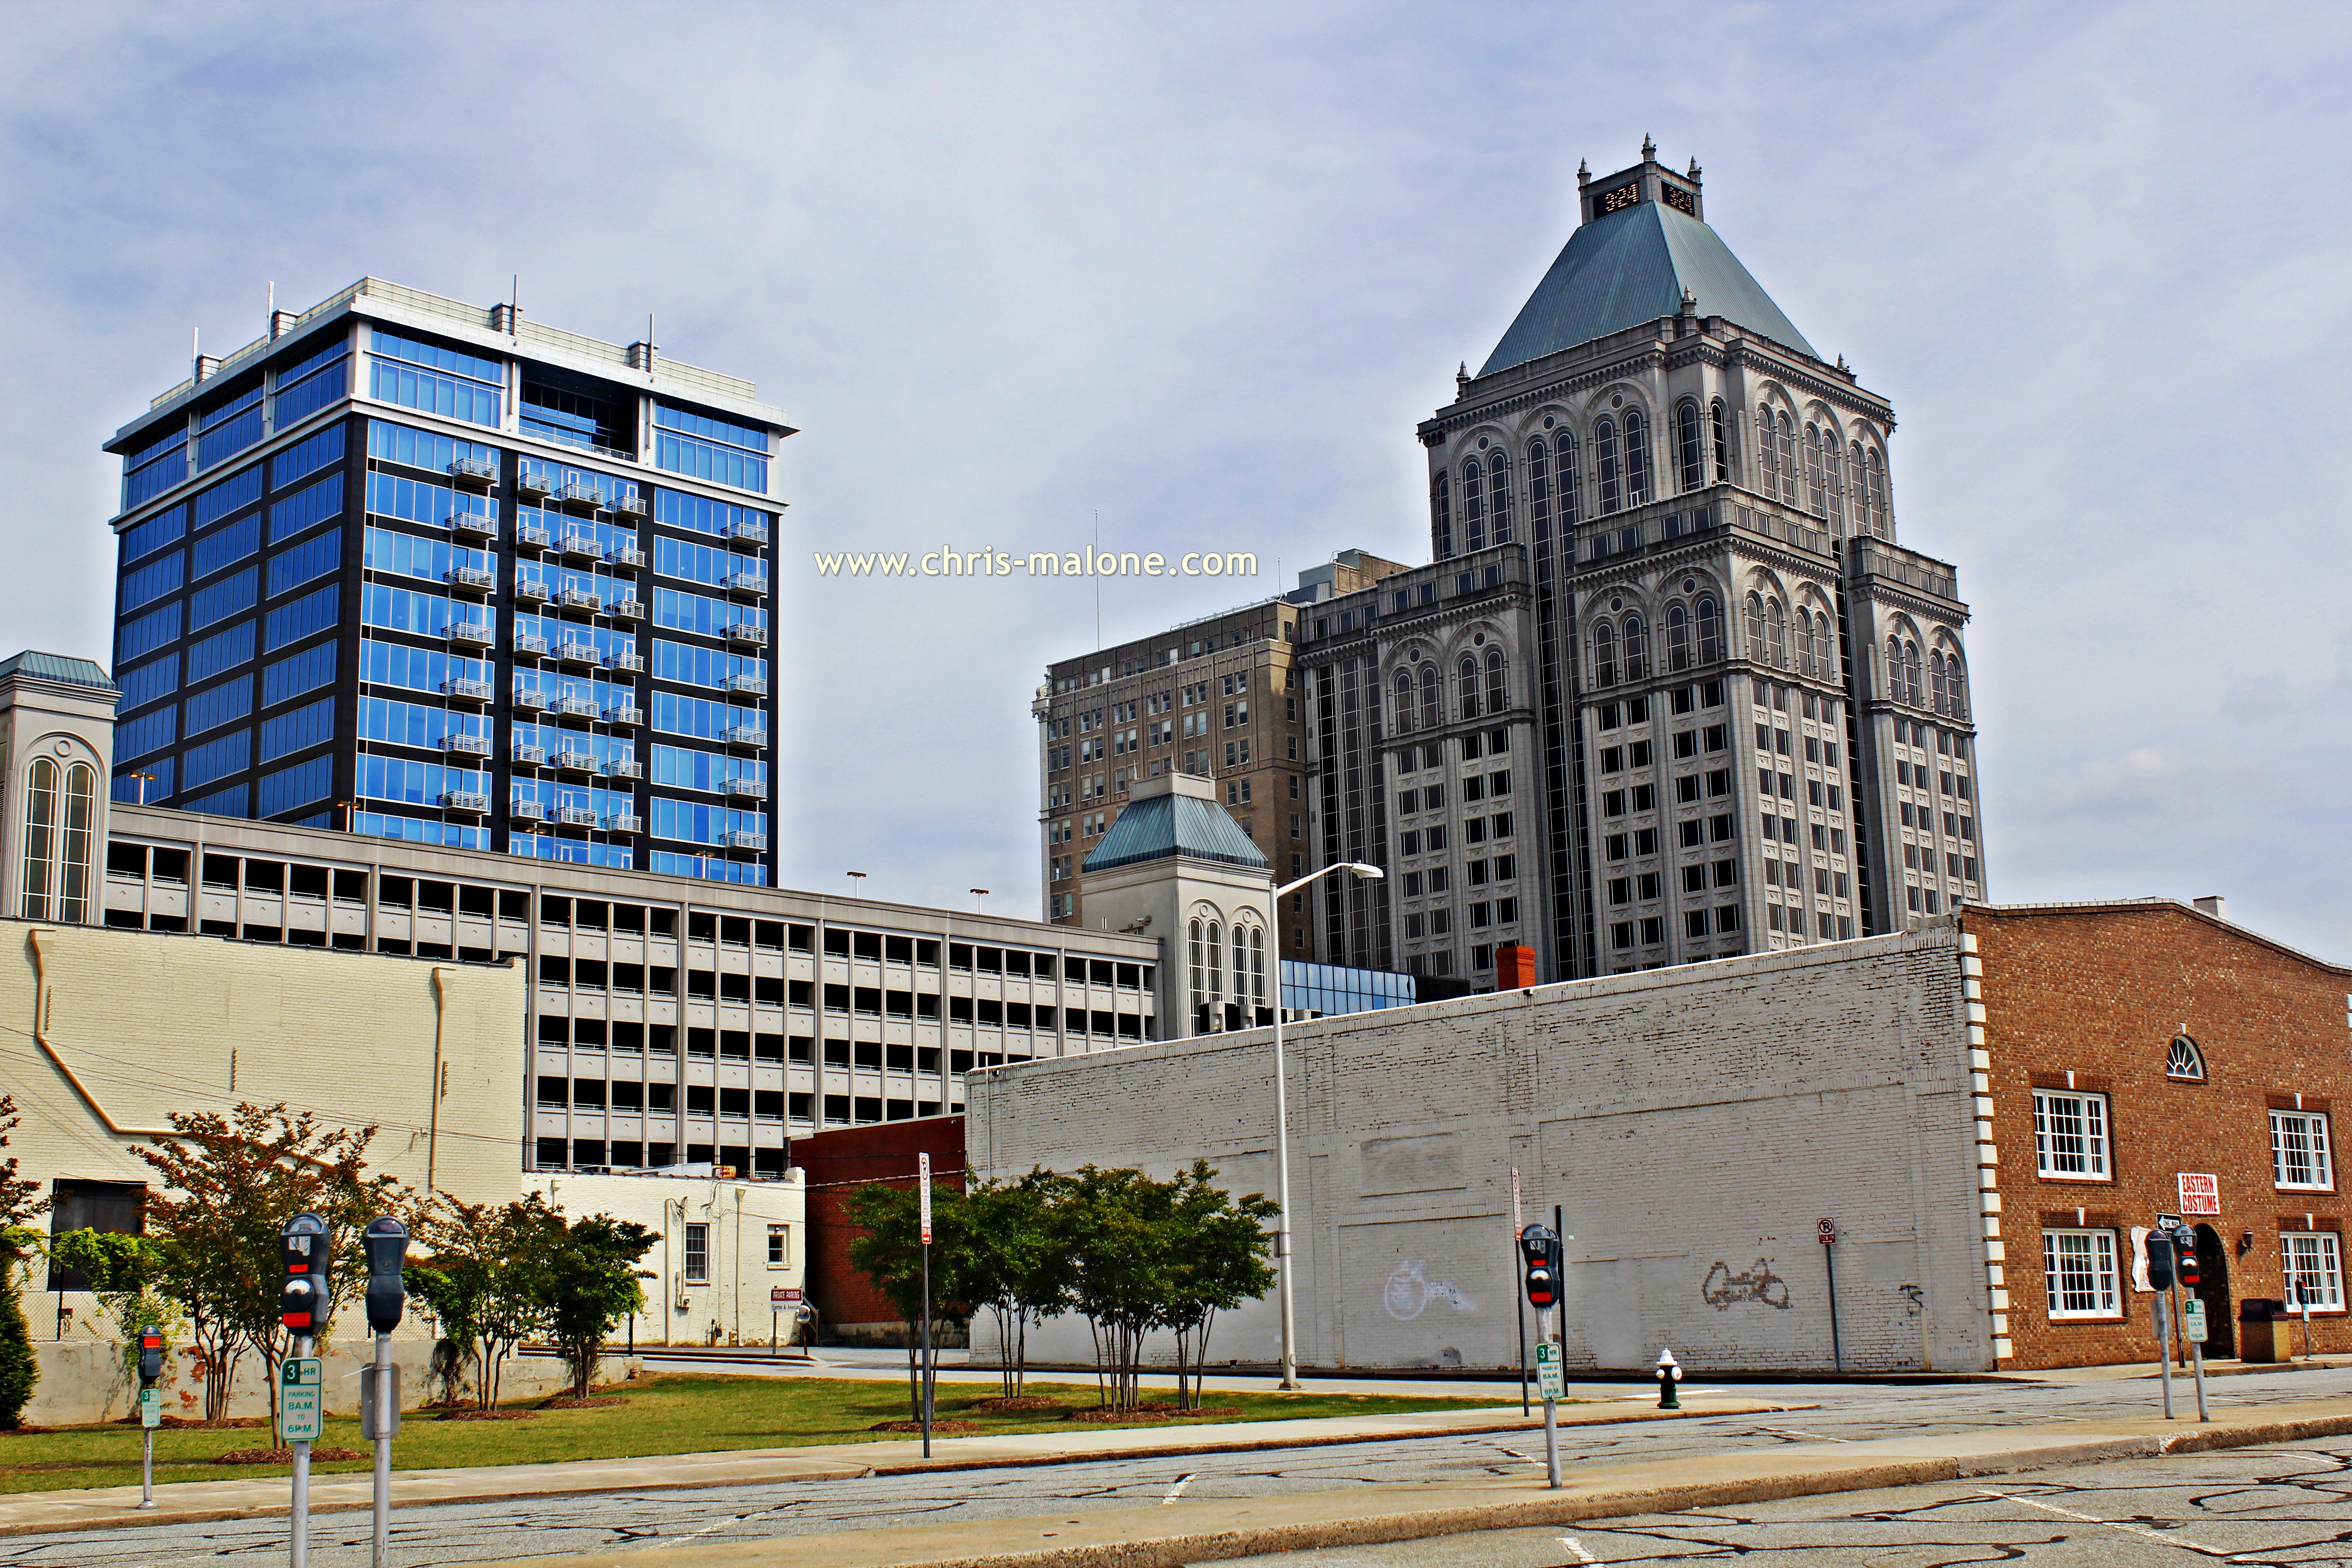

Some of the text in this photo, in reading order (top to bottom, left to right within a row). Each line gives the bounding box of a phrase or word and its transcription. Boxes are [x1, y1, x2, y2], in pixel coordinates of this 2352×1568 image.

[1606, 184, 1639, 211] 3:24
[2182, 1175, 2214, 1193] EASTERN
[2183, 1194, 2217, 1212] COSTUME
[773, 1291, 799, 1299] PRIVATE PARKING
[2187, 1303, 2192, 1311] 3
[1540, 1348, 1545, 1359] 3
[287, 1364, 316, 1380] 3 HR
[288, 1401, 315, 1410] 8A.M.
[287, 1423, 314, 1433] 6P.M.
